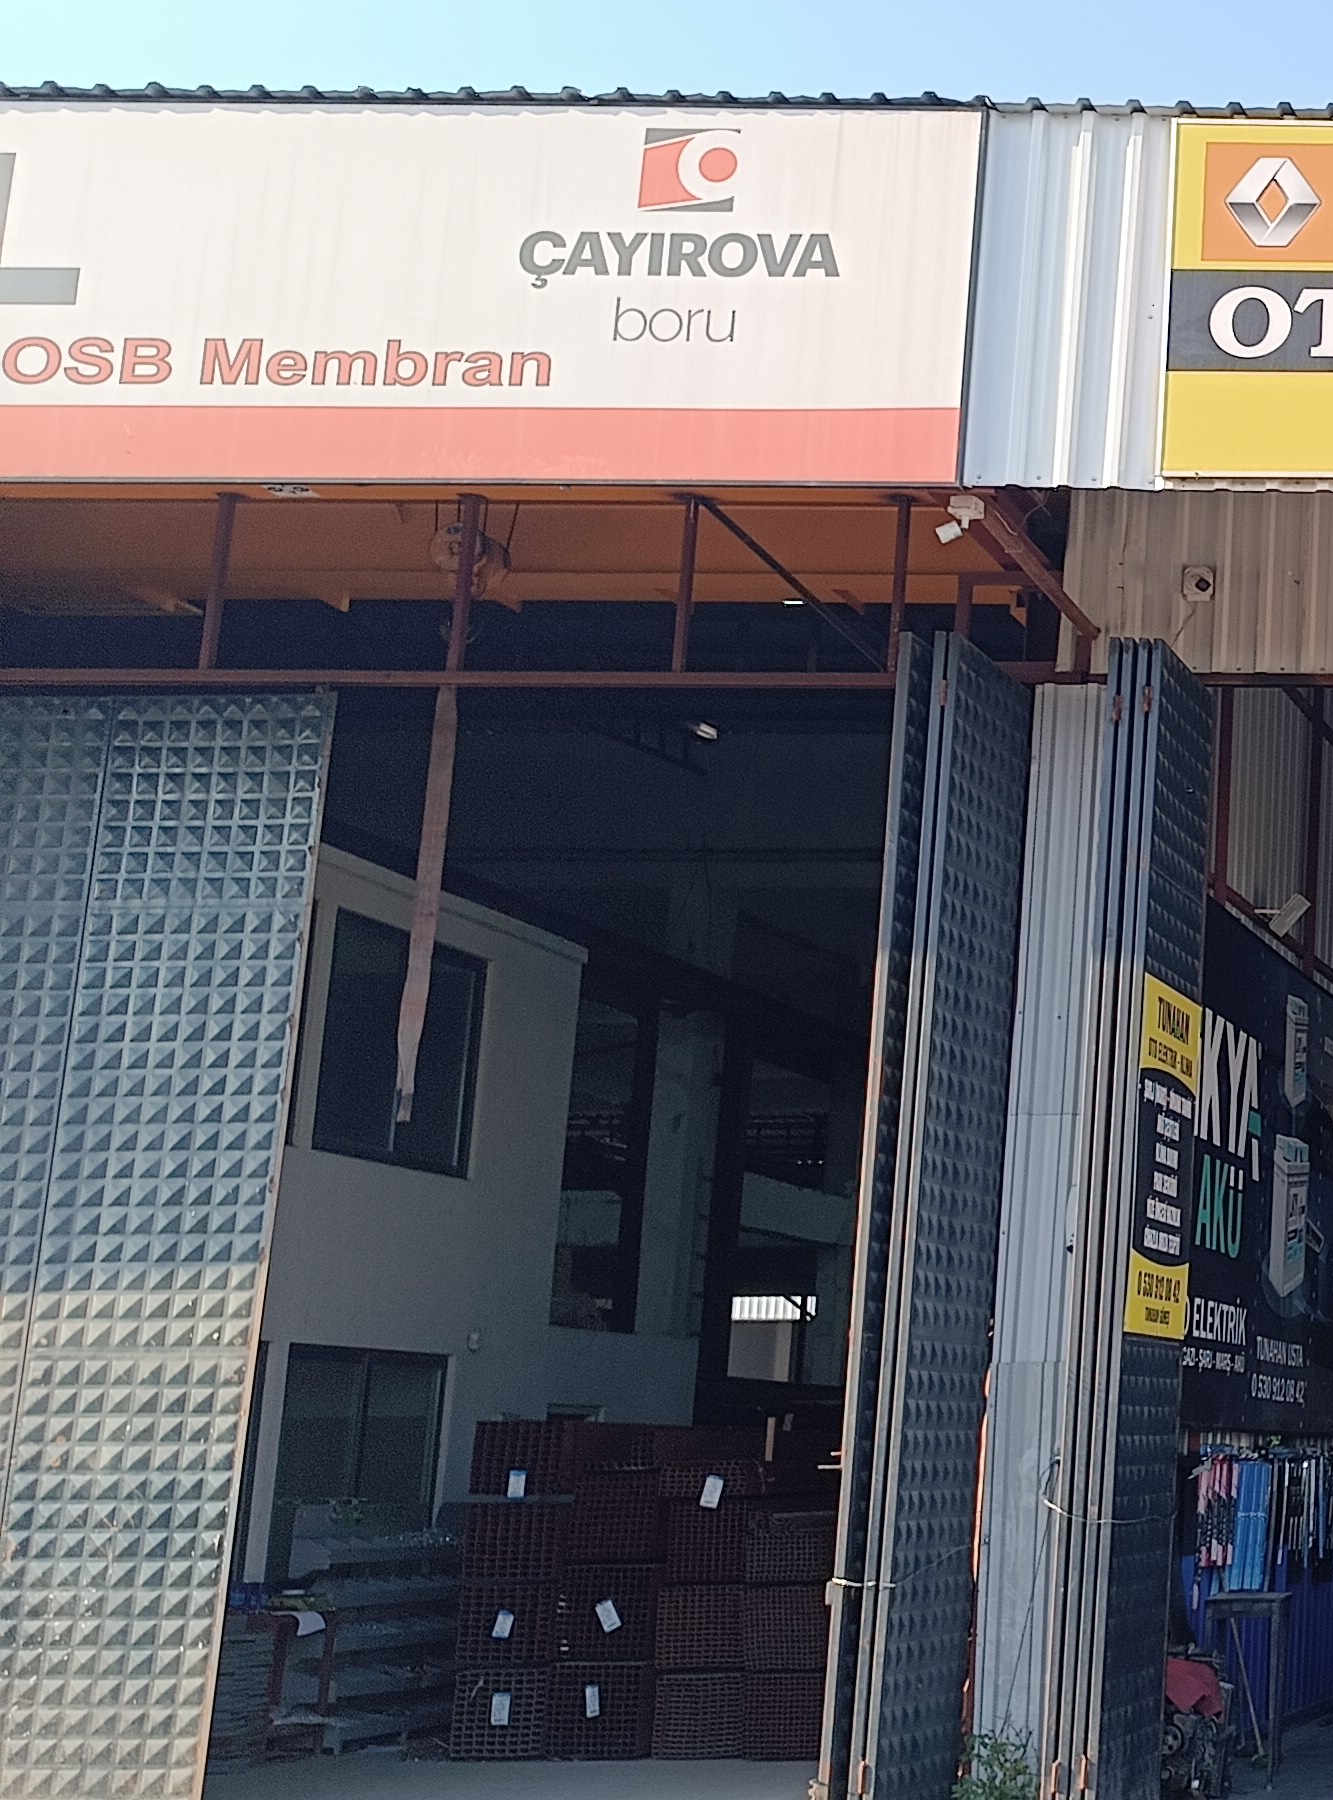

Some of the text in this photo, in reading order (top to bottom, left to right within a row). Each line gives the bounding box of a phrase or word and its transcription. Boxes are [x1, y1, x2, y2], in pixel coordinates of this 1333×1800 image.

[519, 231, 840, 289] ÇAYIROVA
[612, 297, 737, 343] boru
[3, 337, 553, 388] OSB Membran
[1194, 1153, 1244, 1260] AKÜ
[1192, 1298, 1248, 1346] ELEKTRİK
[1256, 1335, 1305, 1368] TUNAHAN USTA
[1251, 1373, 1305, 1405] 0 530 912 08 42
